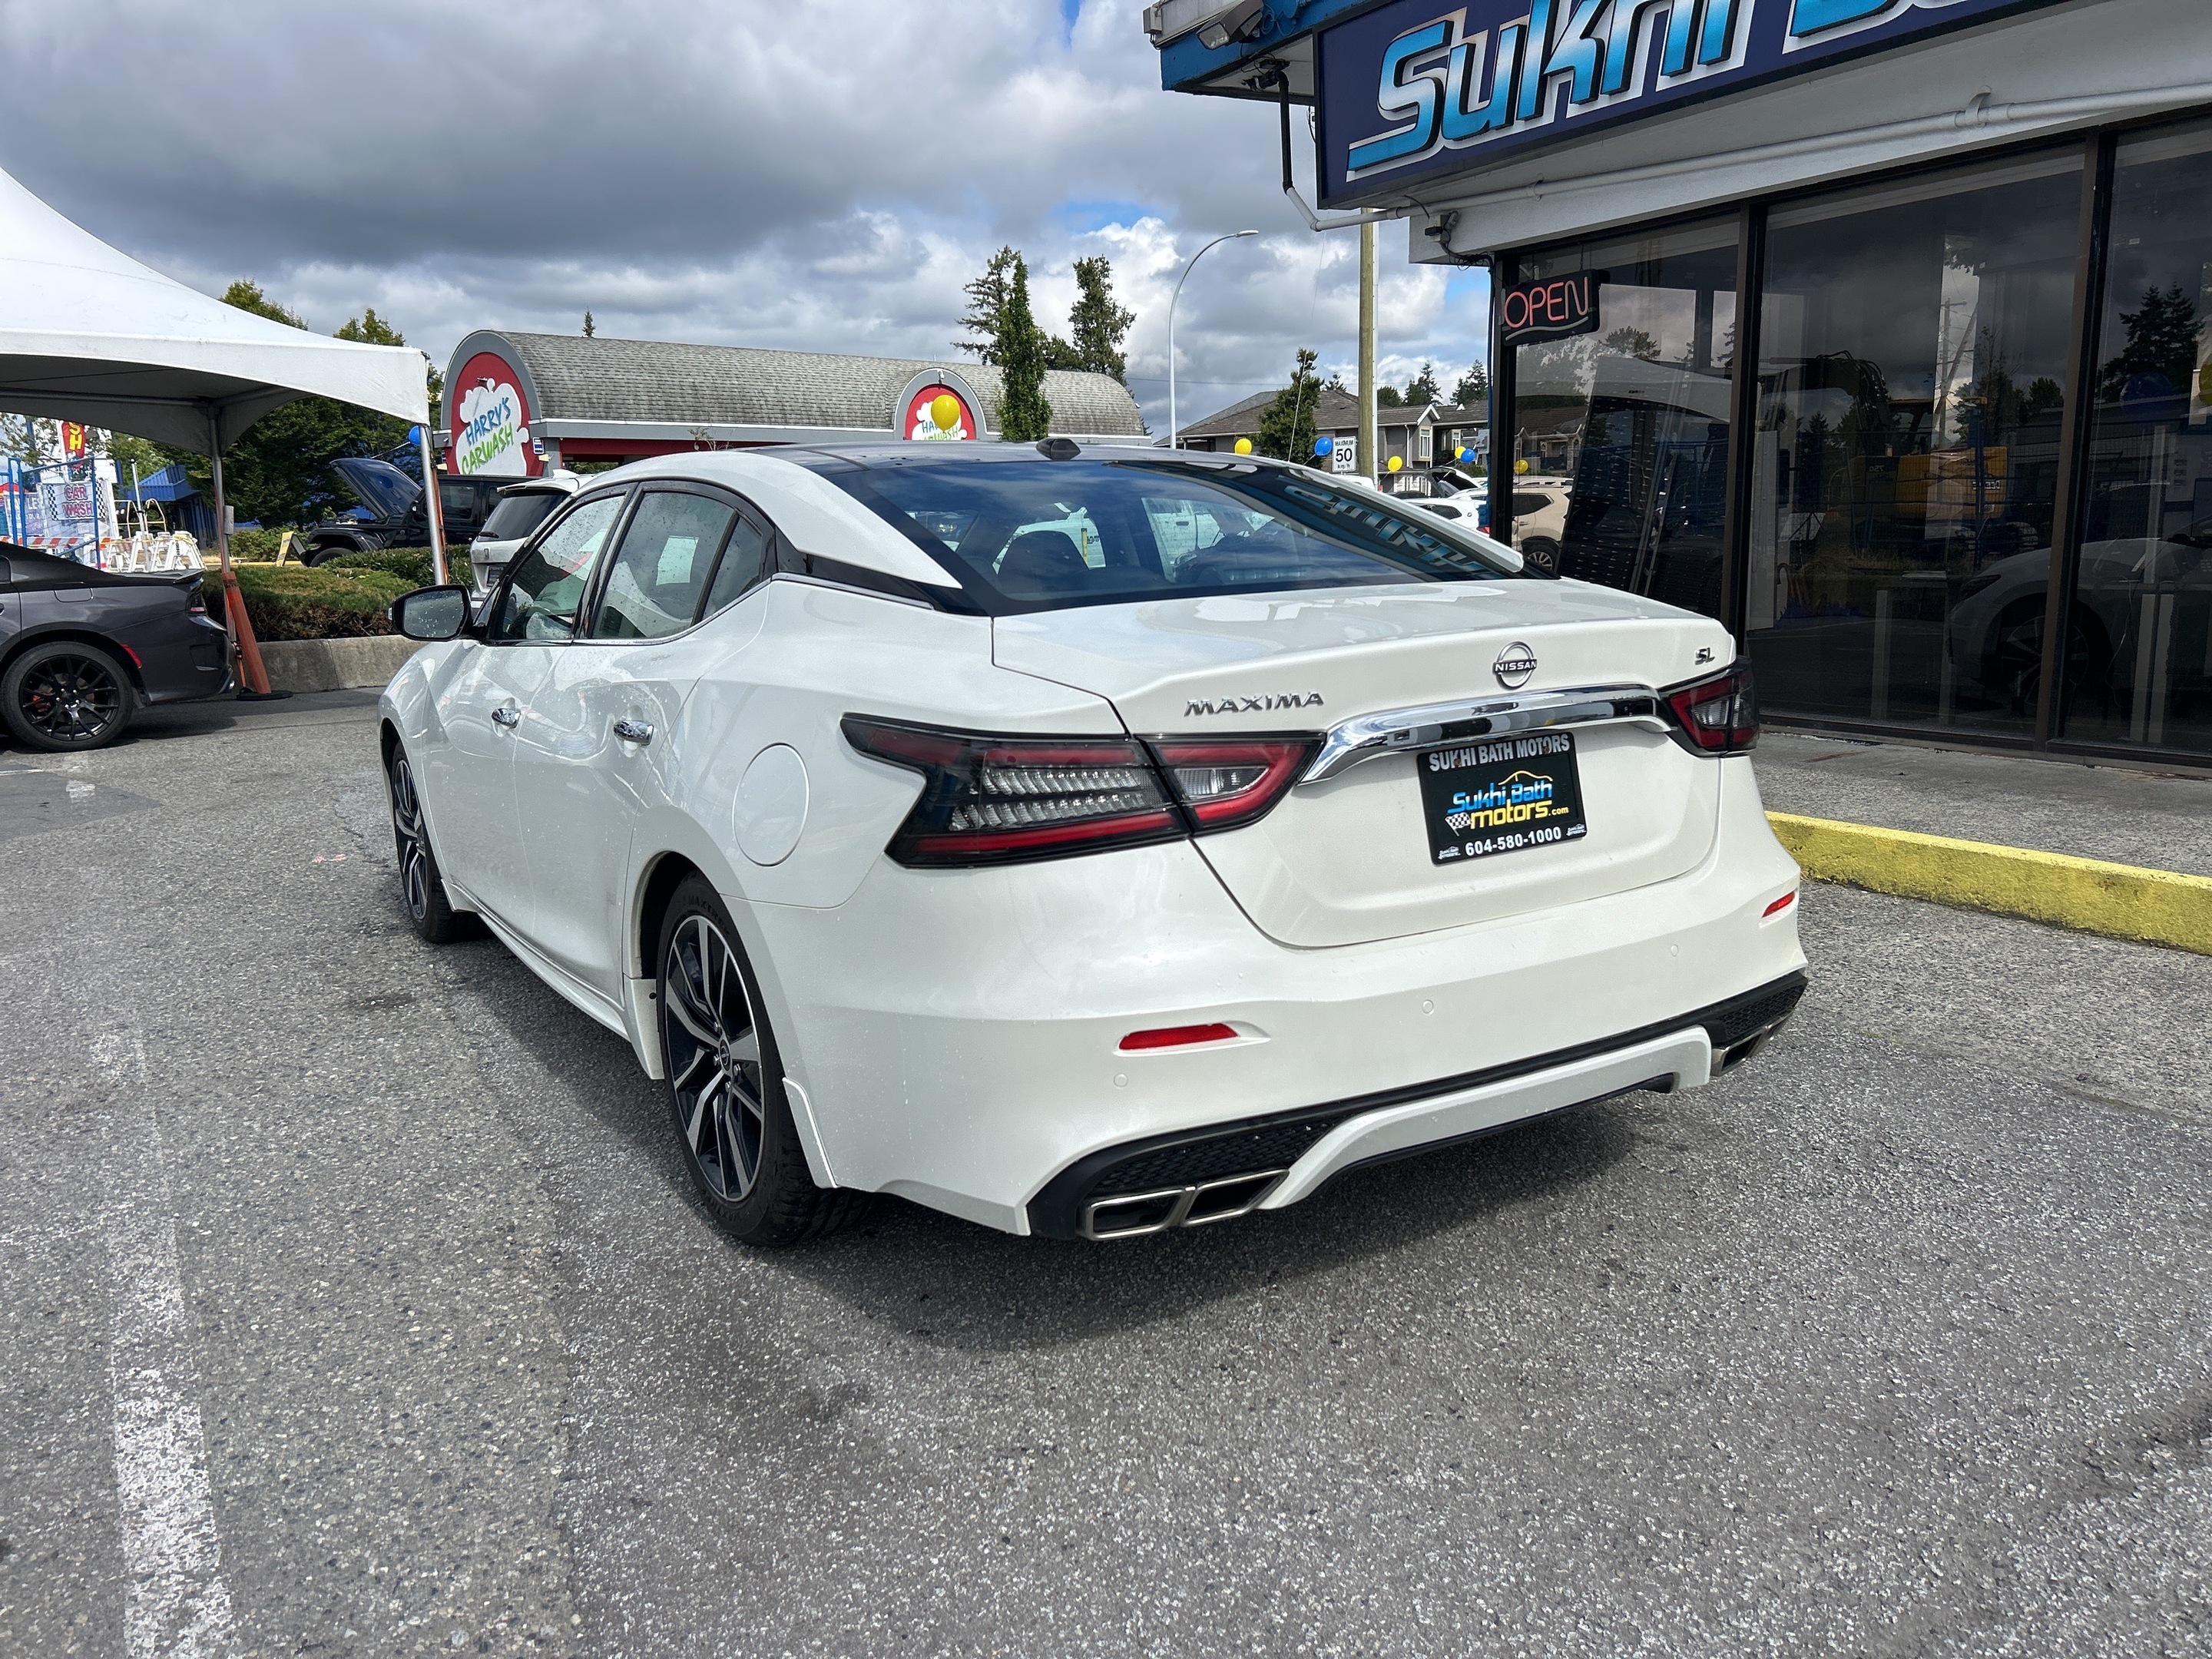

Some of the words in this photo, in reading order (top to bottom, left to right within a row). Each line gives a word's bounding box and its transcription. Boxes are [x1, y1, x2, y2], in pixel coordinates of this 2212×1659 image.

[1504, 276, 1589, 329] OPEN
[465, 396, 512, 446] HARRY'S
[462, 422, 515, 475] CARWASH
[1336, 448, 1353, 462] 50
[65, 485, 88, 500] CAR
[62, 502, 93, 518] WASH
[1495, 661, 1536, 672] NISSAN
[1694, 647, 1715, 665] SL
[1184, 693, 1323, 716] MAXIMA
[1429, 747, 1477, 772] SUKHI
[1479, 740, 1514, 764] BATH
[1516, 733, 1570, 759] MOTORS
[1447, 782, 1505, 814] Sukhi
[1511, 780, 1553, 803] Bath
[1465, 826, 1561, 856] 604-580-1000
